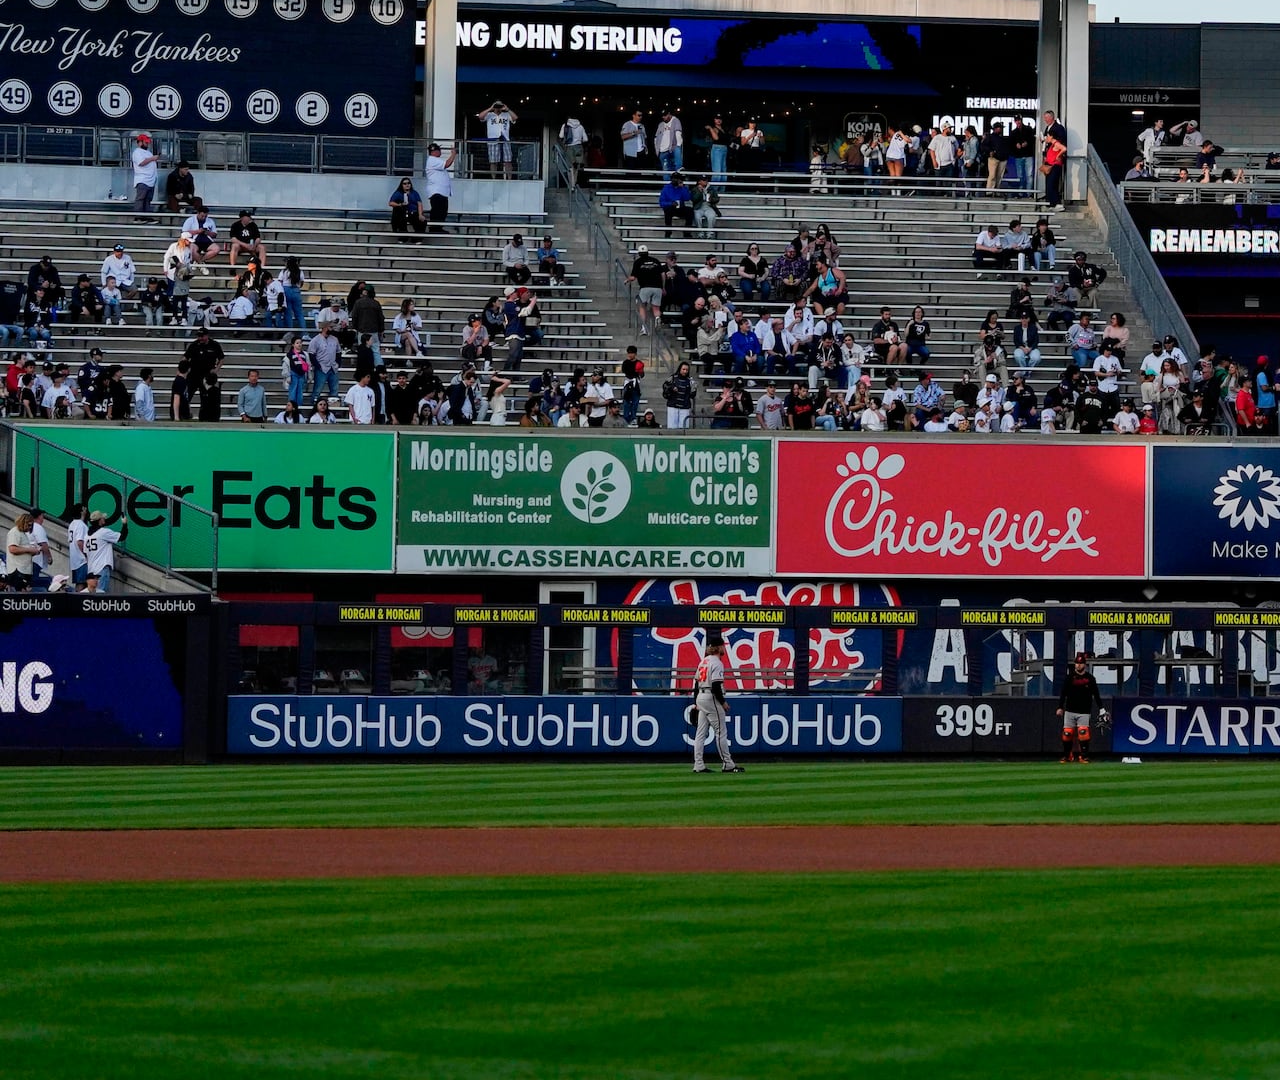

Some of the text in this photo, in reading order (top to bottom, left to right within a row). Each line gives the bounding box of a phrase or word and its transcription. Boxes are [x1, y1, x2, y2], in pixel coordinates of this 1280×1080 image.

[378, 0, 396, 16] 10
[496, 23, 563, 49] JOHN
[570, 25, 683, 53] STERLING
[0, 23, 241, 74] New York Yankees
[2, 87, 370, 119] 49 42 6 51 46 20 2 21
[1119, 93, 1154, 103] WOMEN
[847, 122, 882, 133] KONA
[411, 443, 553, 480] Morningside
[634, 443, 760, 475] Workmen's
[30, 467, 377, 530] Uber Eats
[689, 476, 758, 506] Circle
[472, 494, 552, 510] Nursing and
[825, 450, 1099, 567] Chick-fil-A
[411, 510, 552, 524] Rehabilitation Center
[647, 512, 759, 526] MultiCare Center
[85, 538, 98, 552] 45
[1212, 540, 1269, 560] Make
[424, 549, 746, 569] WWW.CASSENACARE.COM
[2, 598, 52, 611] StubHub
[82, 599, 131, 612] StubHub
[147, 599, 196, 612] StubHub
[341, 606, 421, 621] MORGAN & MORGAN
[455, 608, 536, 622] MORGAN & MORGAN
[563, 608, 648, 623] MORGAN & MORGAN
[700, 609, 784, 623] MORGAN & MORGAN
[833, 610, 916, 624] MORGAN & MORGAN
[962, 611, 1044, 624] MORGAN & MORGAN
[1090, 612, 1171, 625] MORGAN & MORGAN
[1216, 612, 1250, 626] MORGAN
[1252, 612, 1259, 626] &
[249, 703, 882, 748] StubHub StubHub StubHub
[936, 703, 1012, 737] 399 FT
